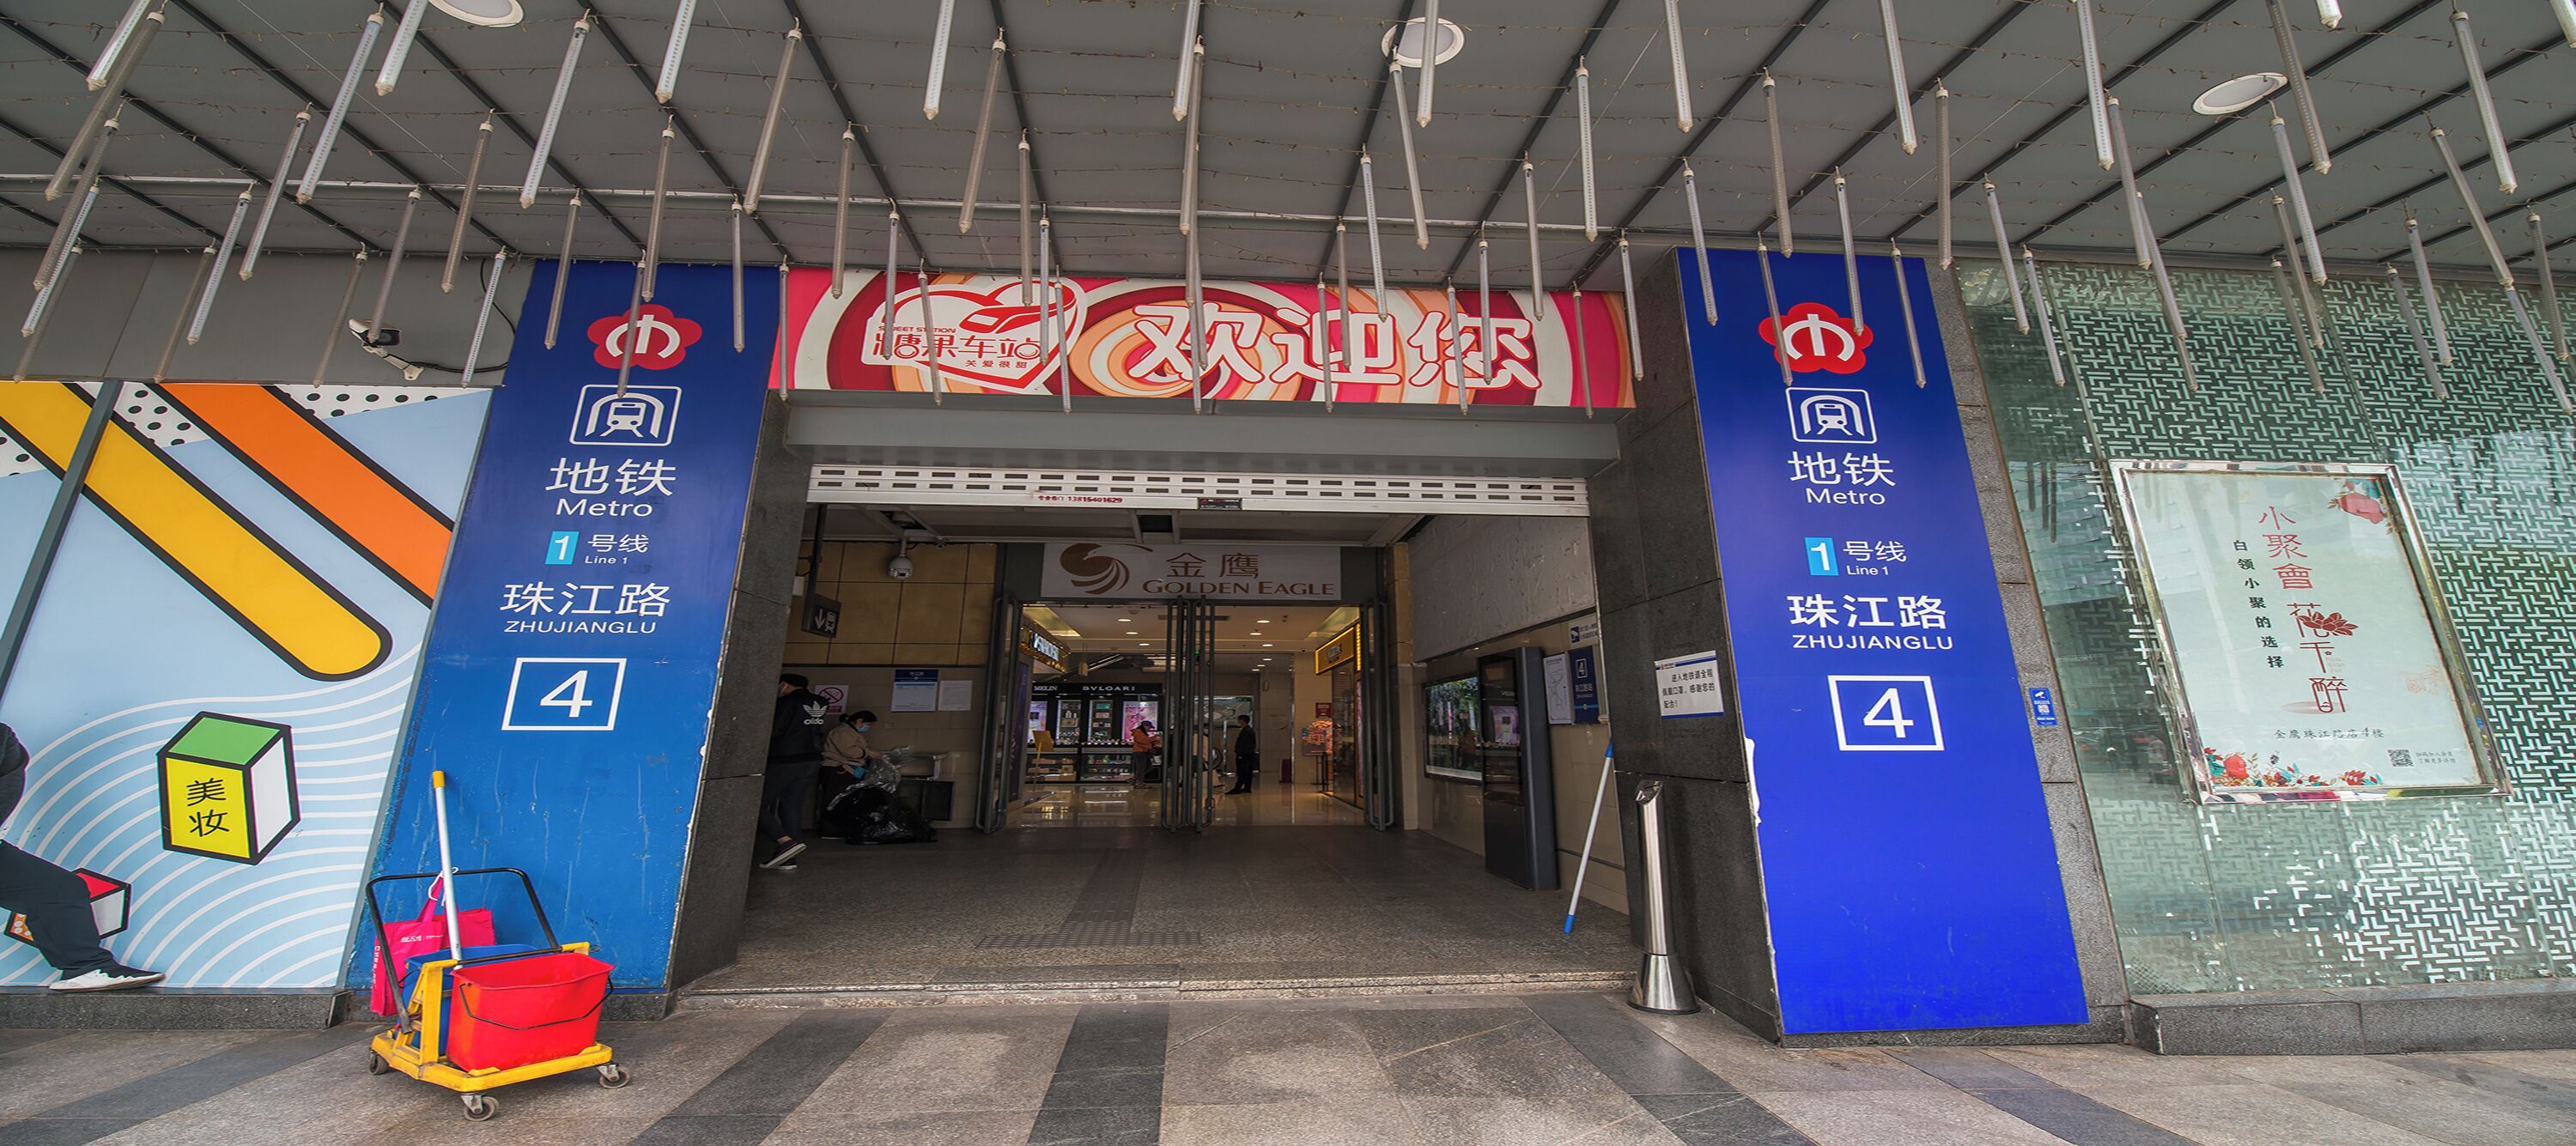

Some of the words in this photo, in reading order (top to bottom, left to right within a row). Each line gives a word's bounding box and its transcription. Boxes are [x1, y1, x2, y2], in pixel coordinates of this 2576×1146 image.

[872, 333, 1041, 360] 糖果车站
[1128, 302, 1542, 389] 欢迎您
[965, 360, 1028, 369] 关爱很甜
[544, 457, 677, 496] 地铁
[1787, 451, 1896, 487] 地铁
[556, 498, 653, 517] Metro
[1805, 488, 1886, 505] Metro
[555, 536, 569, 561] 1
[587, 534, 649, 553] 号线
[584, 555, 616, 565] Line
[621, 556, 628, 565] 1
[1811, 543, 1831, 571] 1
[1843, 540, 1907, 562] 号线
[2258, 506, 2313, 590] 小聚會
[1166, 552, 1259, 579] 金鹰
[1846, 565, 1880, 576] Line
[1881, 566, 1889, 575] 1
[499, 581, 671, 617] 珠江路
[1143, 579, 1249, 594] GOLDEN
[1258, 580, 1334, 596] EAGLE
[1786, 593, 1947, 629] 珠江路
[2233, 539, 2284, 669] 白领小聚的选择
[503, 620, 656, 634] ZHUJIANGLU
[1792, 634, 1953, 650] ZHUJIANGLU
[539, 670, 593, 718] 4
[1862, 688, 1914, 738] 4
[185, 777, 230, 838] 美妆
